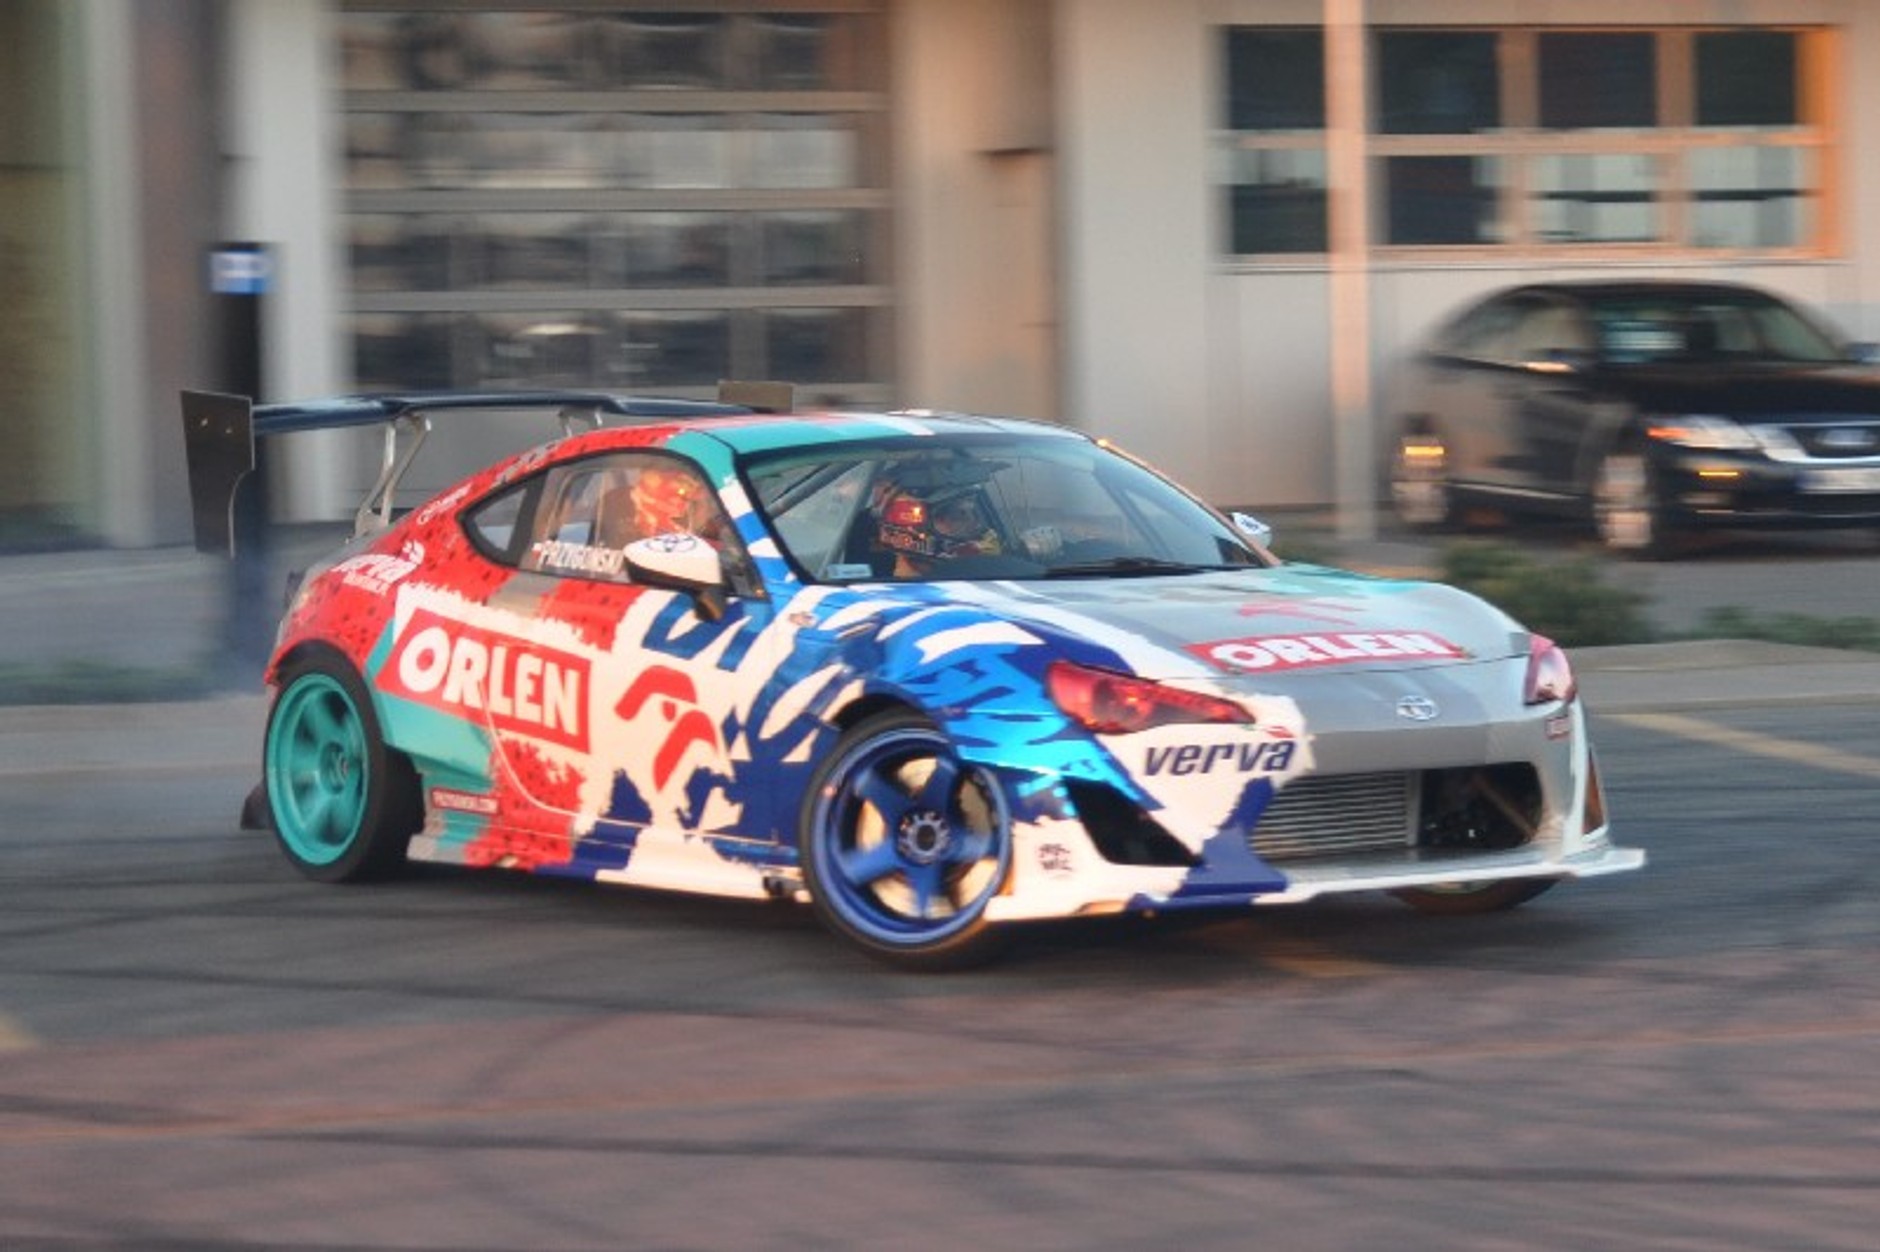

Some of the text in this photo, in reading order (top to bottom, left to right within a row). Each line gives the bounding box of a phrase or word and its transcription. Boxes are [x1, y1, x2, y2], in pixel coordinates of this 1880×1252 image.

[1212, 635, 1455, 668] ORLEN
[399, 627, 580, 737] ORLEN
[1145, 740, 1296, 776] verva
